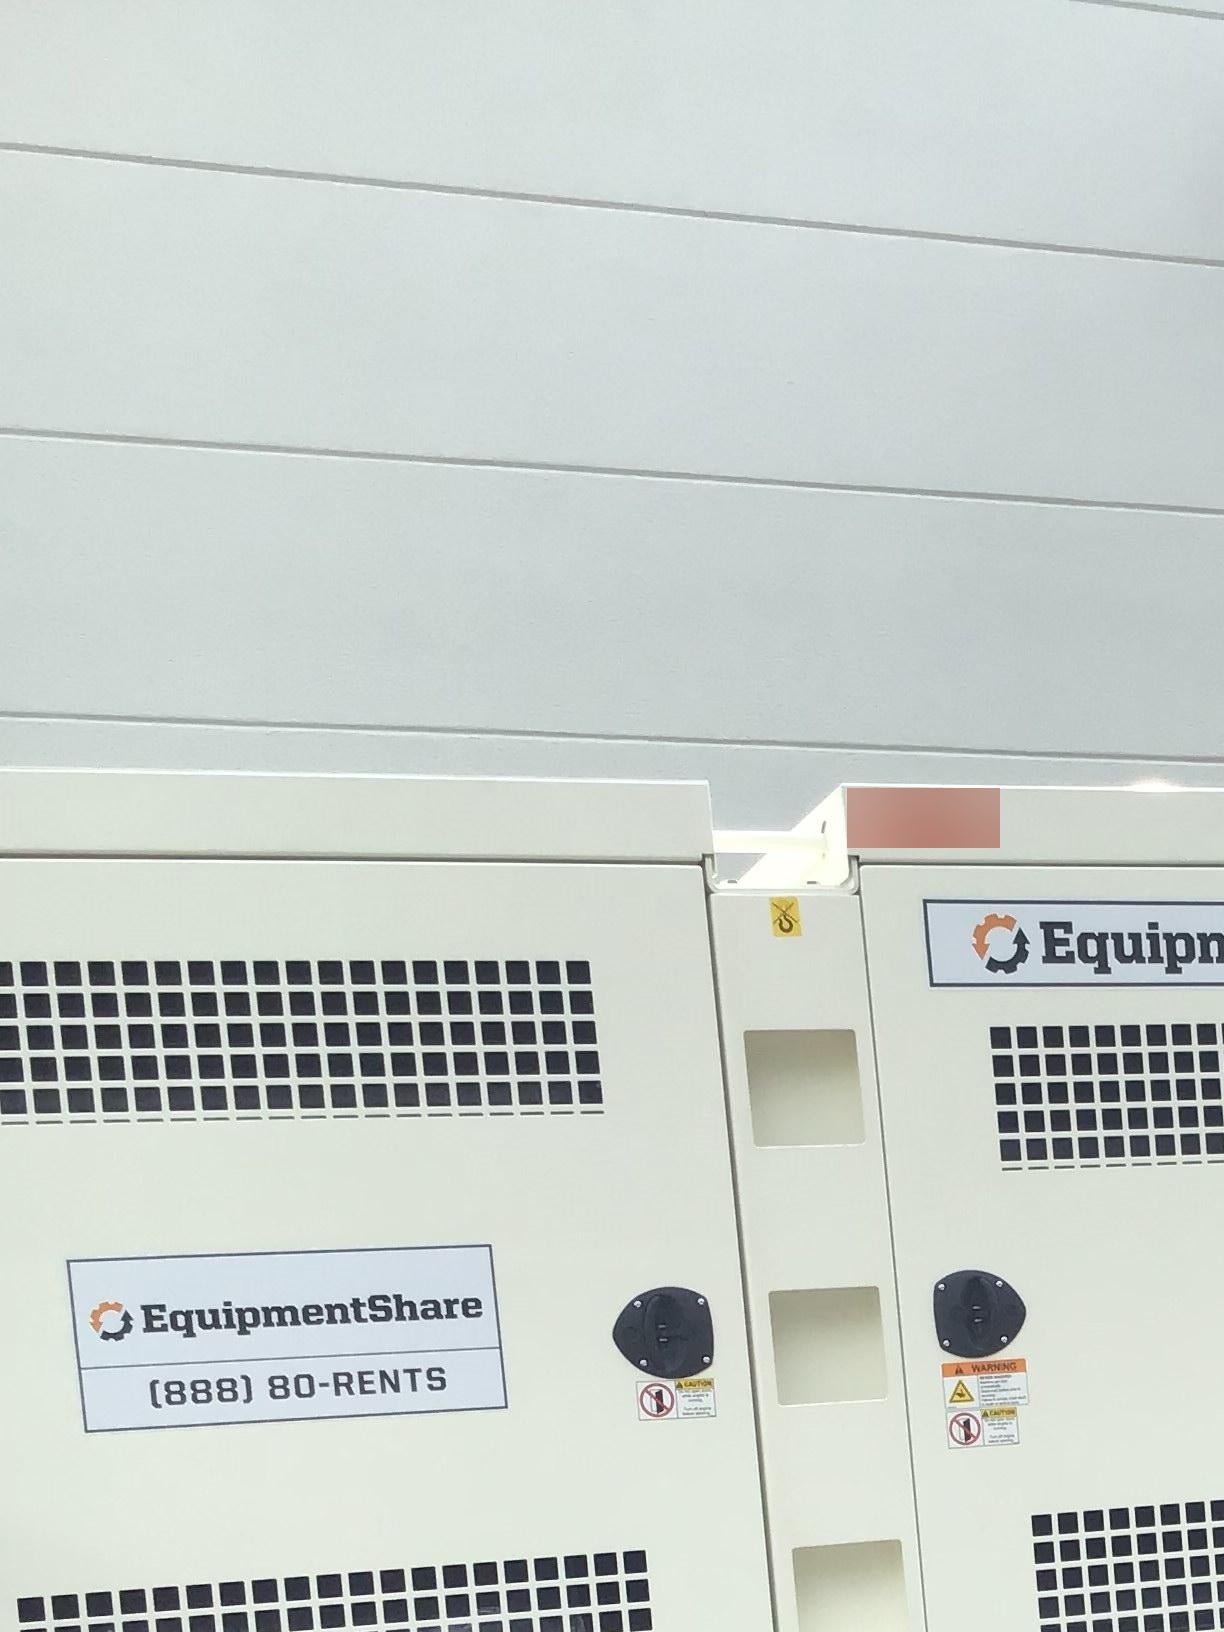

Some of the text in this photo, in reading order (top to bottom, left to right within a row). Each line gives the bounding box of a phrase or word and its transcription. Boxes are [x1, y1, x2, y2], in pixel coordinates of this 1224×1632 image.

[140, 1294, 483, 1338] EquipmentShare
[149, 1366, 448, 1409] (888) 80-RENTS
[971, 1362, 1017, 1373] WARNING
